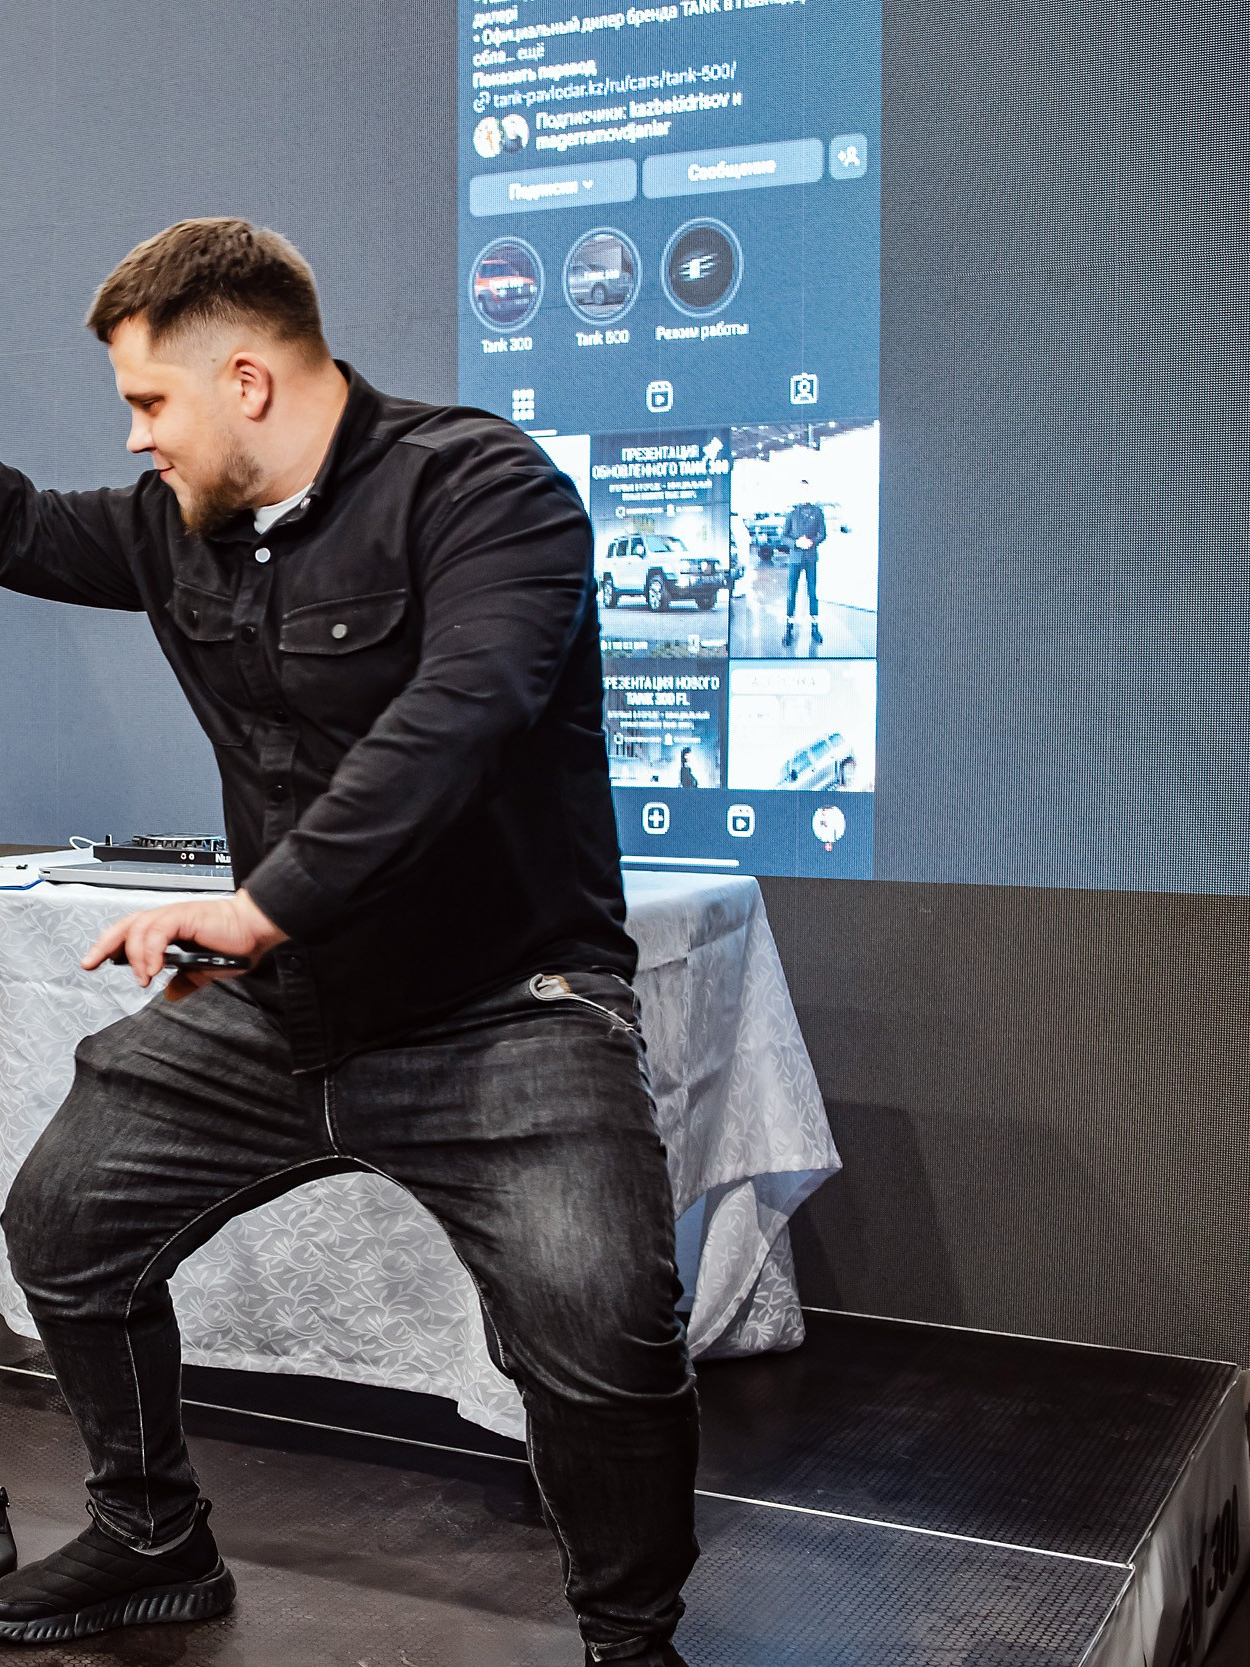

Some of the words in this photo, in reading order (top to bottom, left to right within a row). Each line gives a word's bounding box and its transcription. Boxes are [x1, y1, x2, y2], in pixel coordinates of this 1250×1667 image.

[482, 15, 580, 47] Официальный
[581, 13, 625, 33] дилер
[626, 5, 678, 28] бренда
[680, 0, 721, 16] TANK
[472, 68, 537, 89] Показать
[537, 60, 597, 82] перевод
[535, 106, 627, 130] Подписчики:
[688, 159, 777, 181] Сообщение
[509, 180, 578, 201] Подписки
[576, 331, 603, 346] Tank
[699, 321, 749, 341] работы
[481, 339, 508, 354] Tank
[509, 337, 533, 352] 300
[621, 445, 700, 462] ПРЕЗЕНТАЦИЯ
[592, 461, 678, 480] ОБНОВЛЕННОГО
[603, 675, 674, 691] РЕЗЕНТАЦИЯ
[676, 675, 720, 691] НОВОГО
